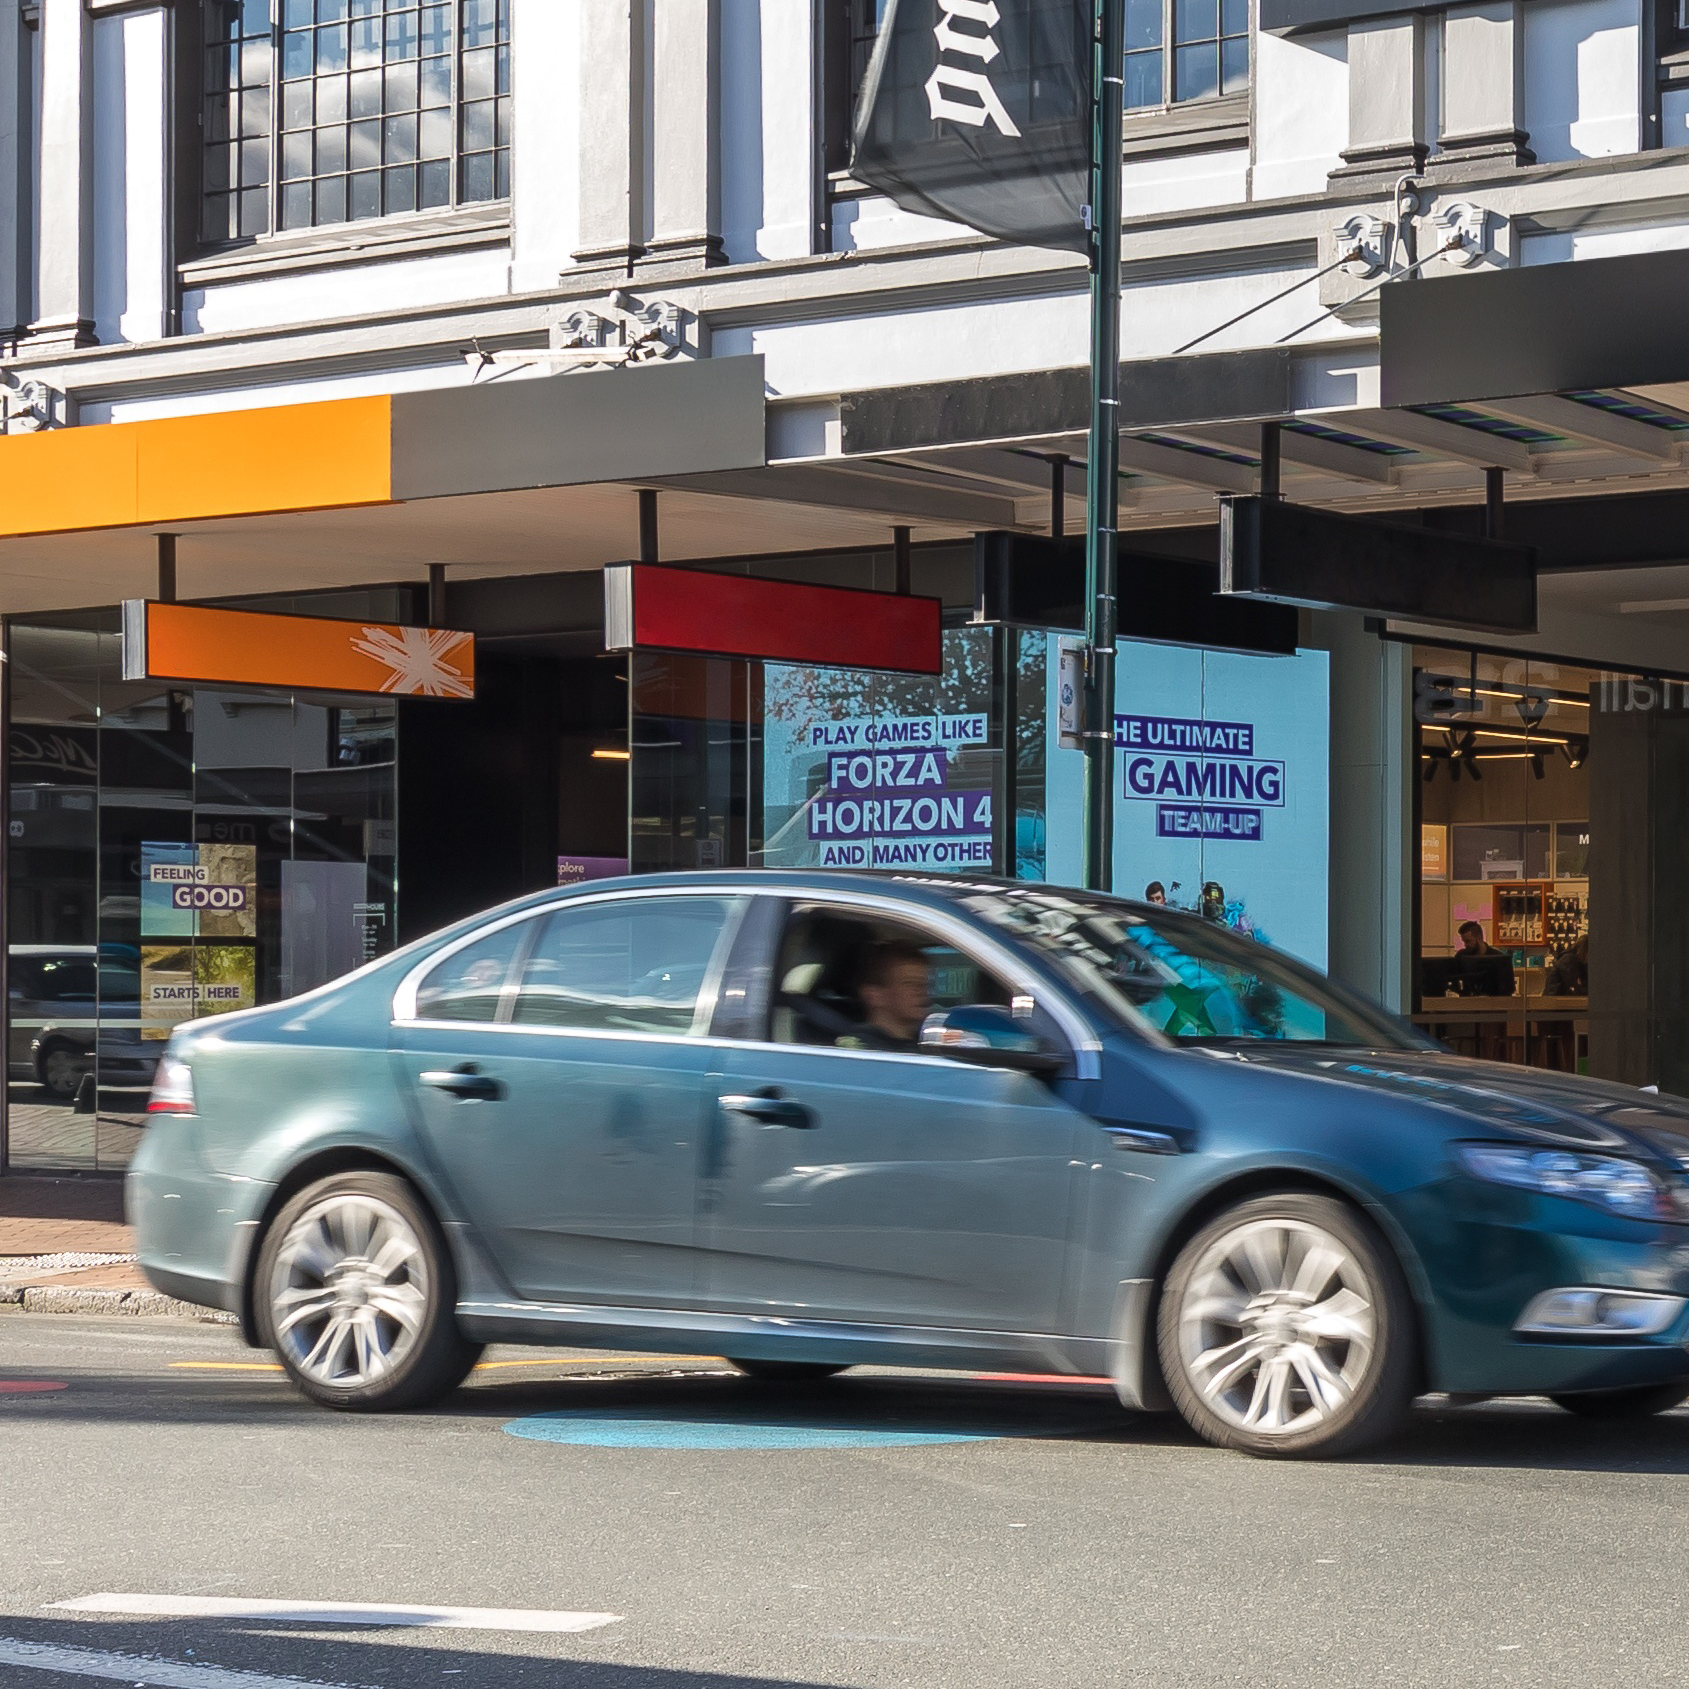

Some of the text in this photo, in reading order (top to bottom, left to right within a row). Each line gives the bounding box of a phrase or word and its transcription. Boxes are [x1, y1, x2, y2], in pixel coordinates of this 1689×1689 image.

[812, 719, 983, 746] PLAY GAMES LIKE
[1113, 720, 1250, 750] HE ULTIMATE
[831, 753, 942, 789] FORZA
[1128, 757, 1280, 801] GAMING
[811, 795, 992, 834] HORIZON 4
[1161, 810, 1259, 835] TEAM-UP
[824, 845, 865, 865] AND
[874, 843, 931, 863] MANY
[153, 867, 206, 881] FEELING
[175, 886, 244, 908] GOOD
[153, 987, 240, 999] STARTS HERE
